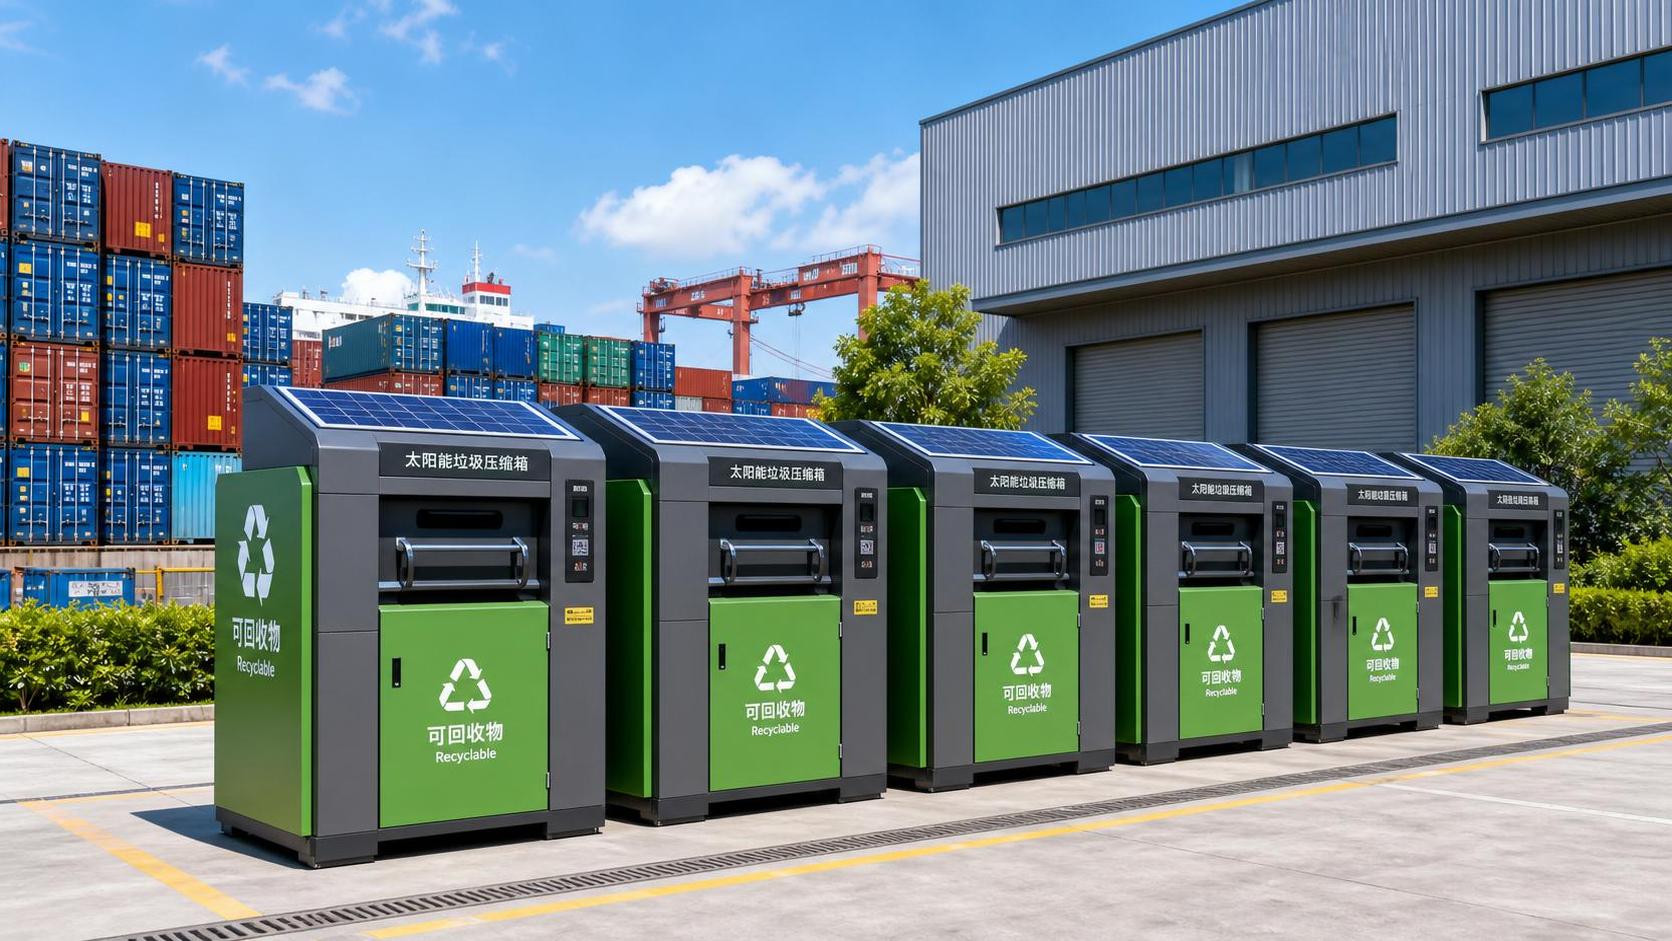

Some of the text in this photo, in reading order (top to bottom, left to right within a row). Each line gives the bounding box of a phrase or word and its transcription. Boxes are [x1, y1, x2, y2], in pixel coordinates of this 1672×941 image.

[405, 450, 529, 472] 太阳能垃圾压缩箱
[730, 464, 825, 482] 太阳能垃圾压缩箱
[232, 617, 281, 653] 可回收物
[237, 655, 275, 678] Recyclable
[1002, 682, 1052, 701] 可回收物
[744, 699, 805, 721] 可回收物
[426, 721, 504, 746] 可回收物
[751, 722, 800, 737] Recyclable
[435, 747, 497, 765] Recyclable
